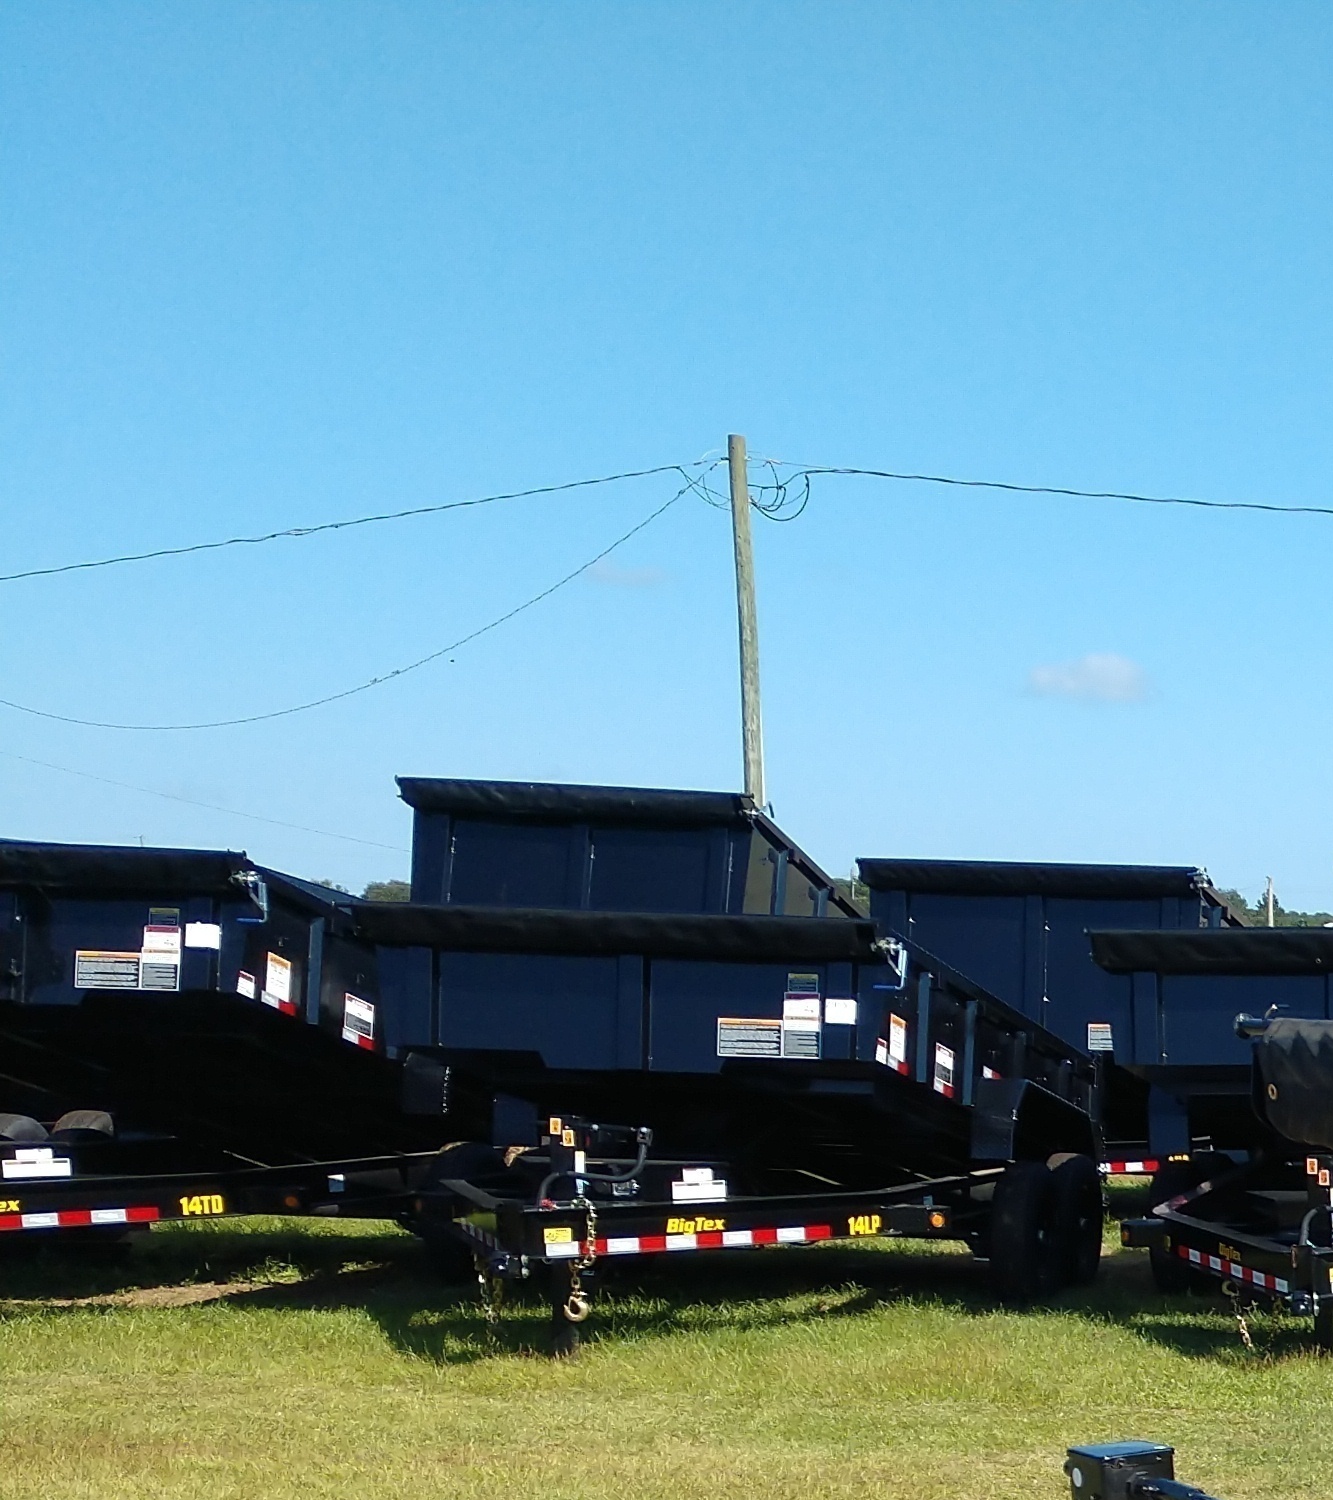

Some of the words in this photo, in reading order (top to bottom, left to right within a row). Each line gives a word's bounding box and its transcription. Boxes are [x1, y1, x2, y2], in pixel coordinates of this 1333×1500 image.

[180, 1195, 224, 1216] 14TD
[666, 1217, 726, 1235] BigTex
[848, 1215, 881, 1236] 14LP
